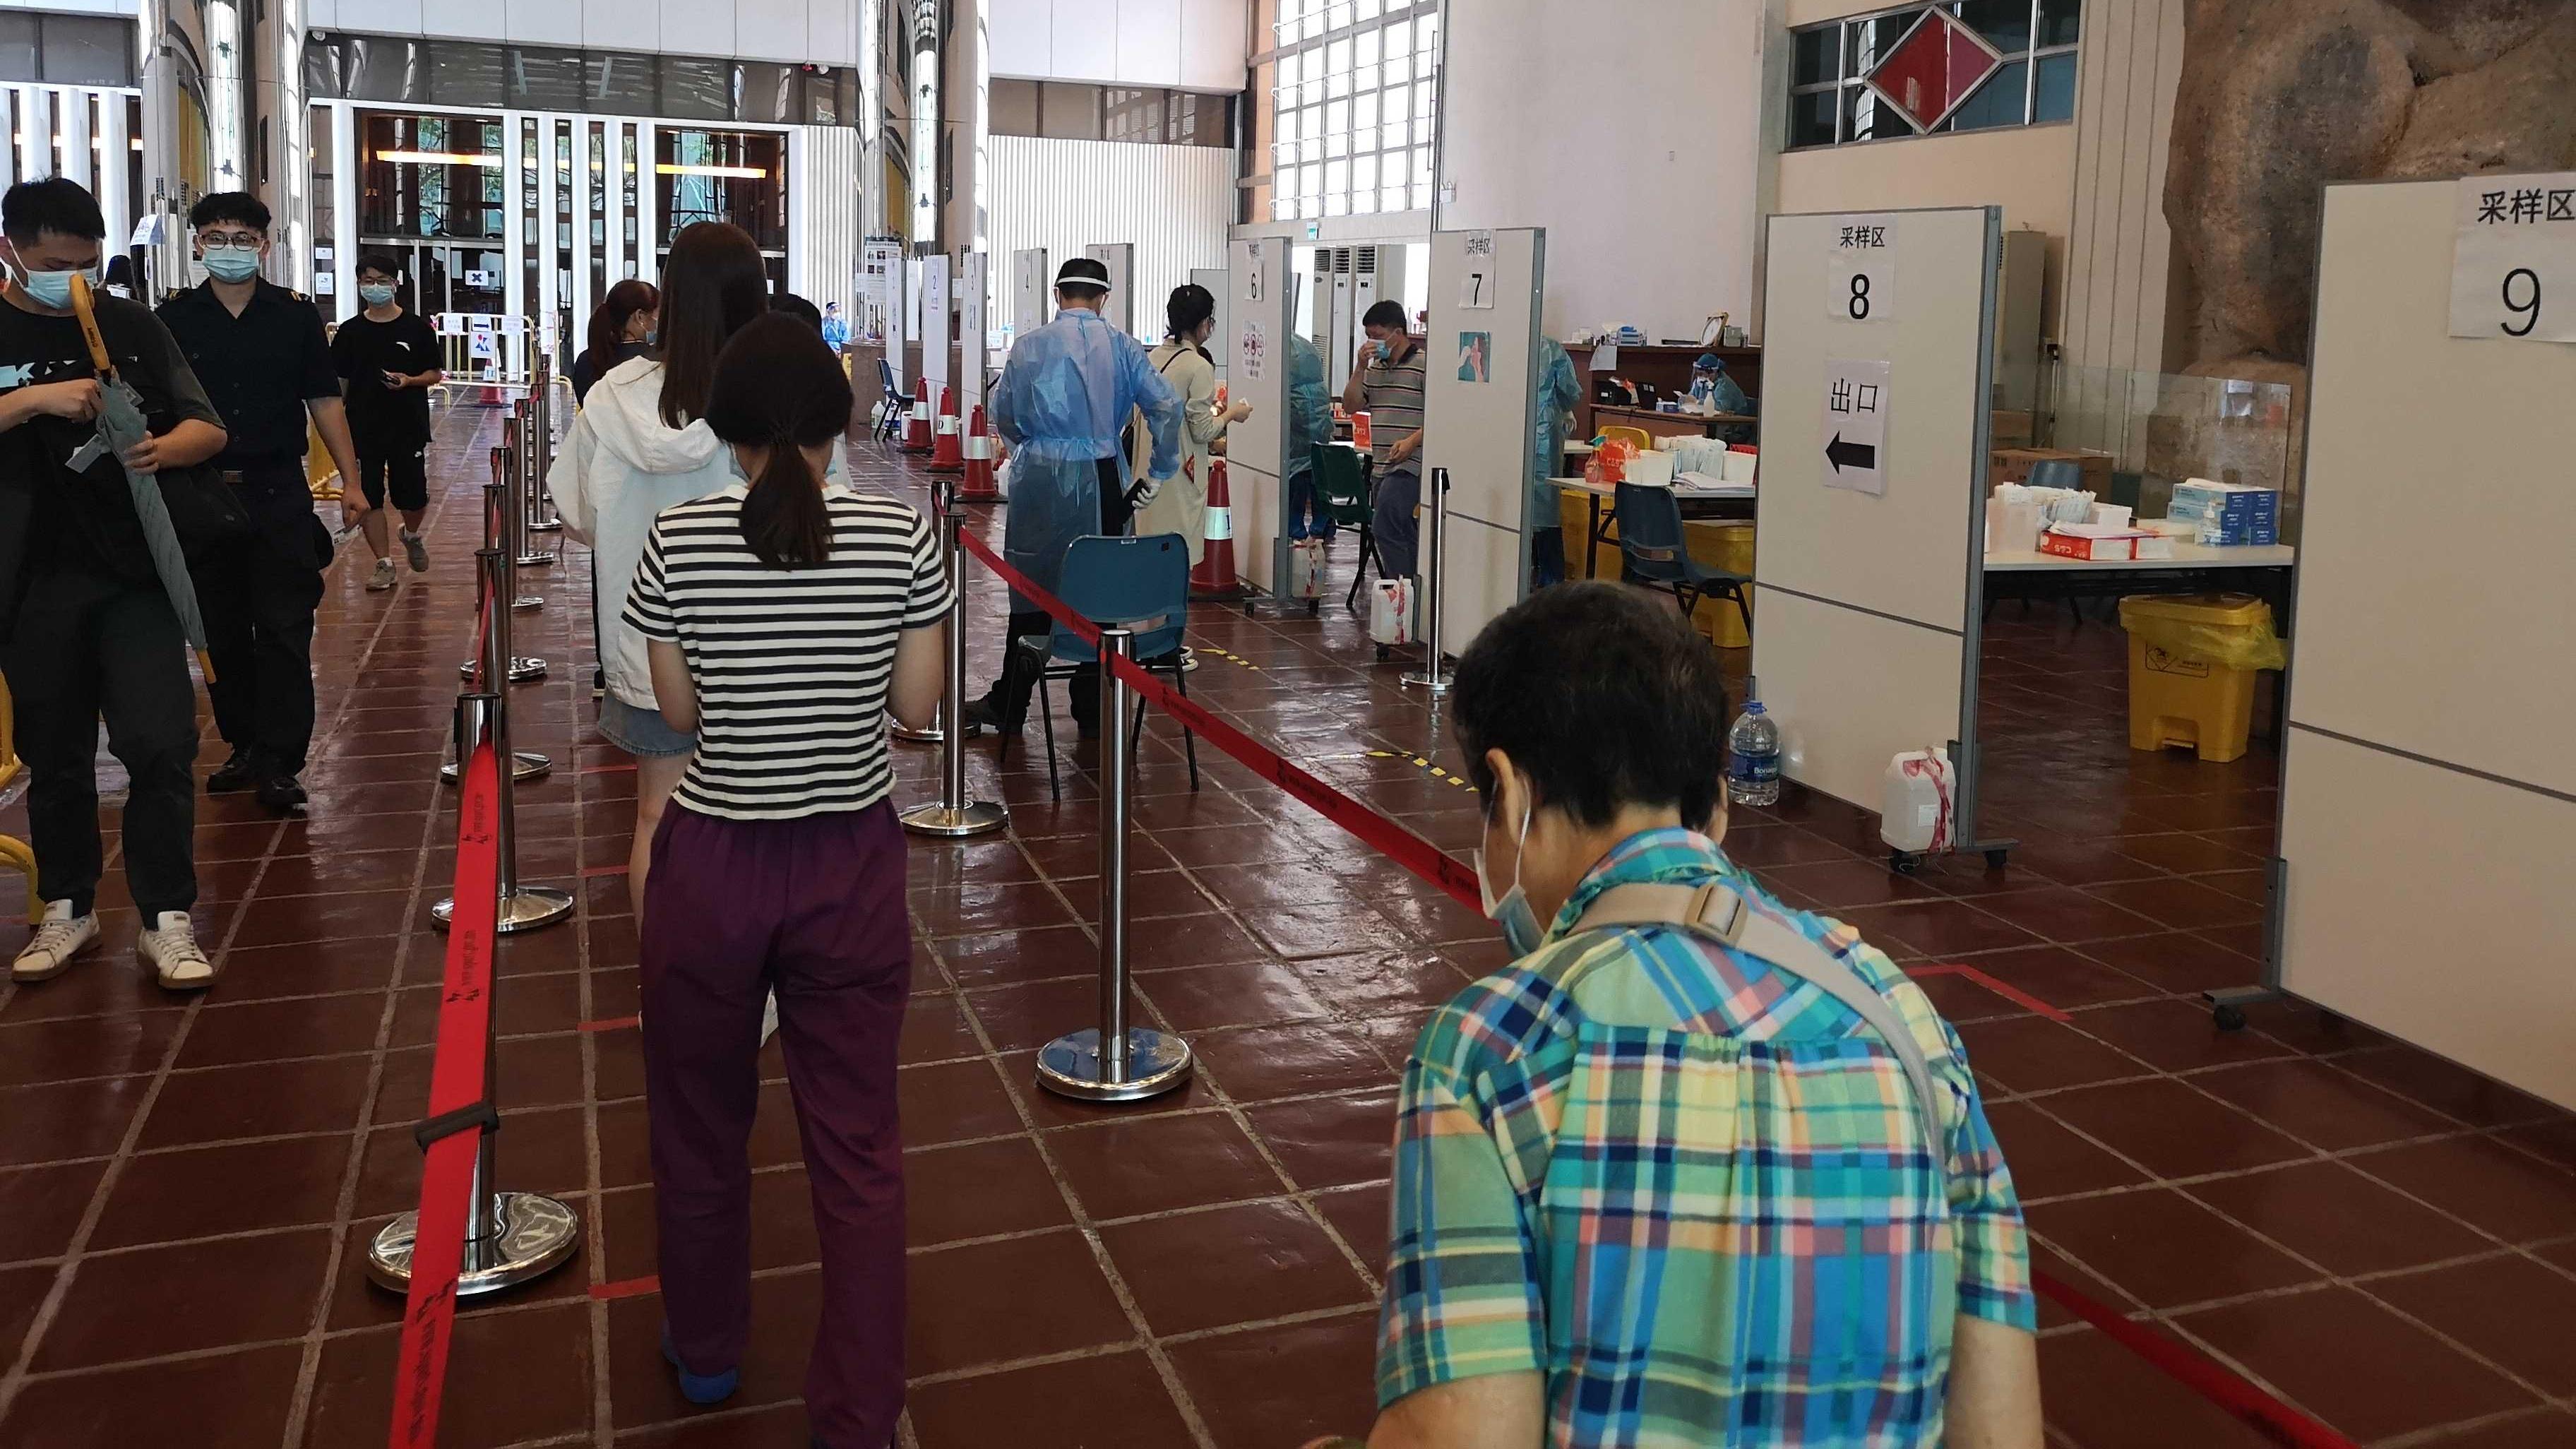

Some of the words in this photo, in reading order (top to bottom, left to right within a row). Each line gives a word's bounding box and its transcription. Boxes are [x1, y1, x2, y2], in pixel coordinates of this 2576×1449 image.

[2478, 189, 2575, 224] 采样区
[1467, 237, 1490, 255] 采样区
[1839, 225, 1885, 249] 采样区
[1251, 273, 1257, 299] 6
[1472, 273, 1482, 306] 7
[1849, 274, 1870, 319] 8
[2500, 268, 2541, 336] 9
[1831, 378, 1878, 414] 出口
